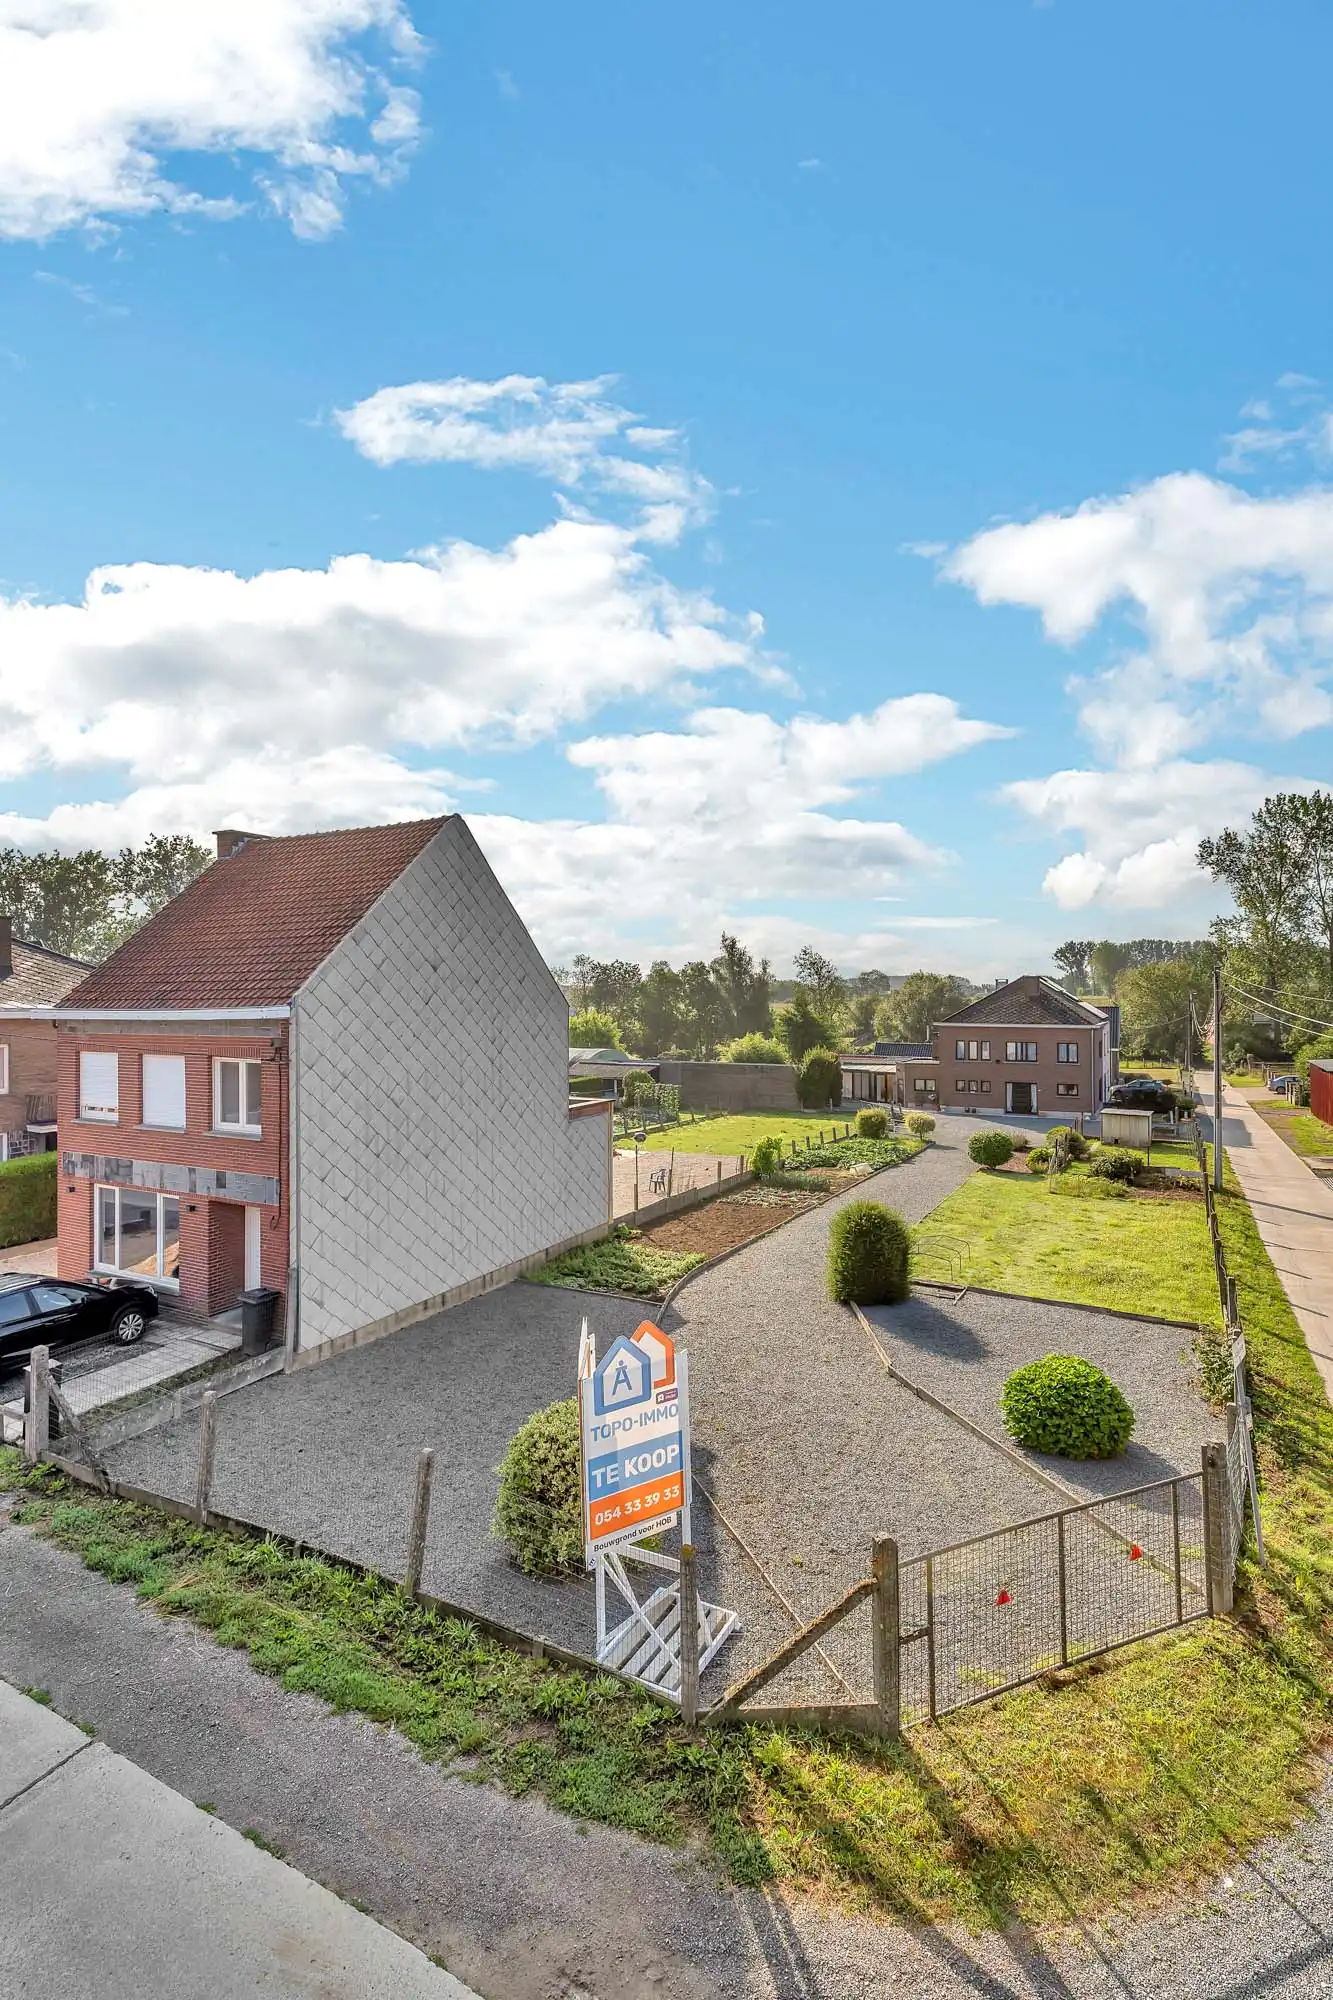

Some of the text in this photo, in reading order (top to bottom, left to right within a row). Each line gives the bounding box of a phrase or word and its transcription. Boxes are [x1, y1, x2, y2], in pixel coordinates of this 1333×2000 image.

[590, 1404, 678, 1441] TOPO-IMMO
[592, 1444, 680, 1488] TE KOOP
[594, 1485, 680, 1525] 054 33 39 33
[593, 1516, 672, 1552] Bouwgrond voor HOB
